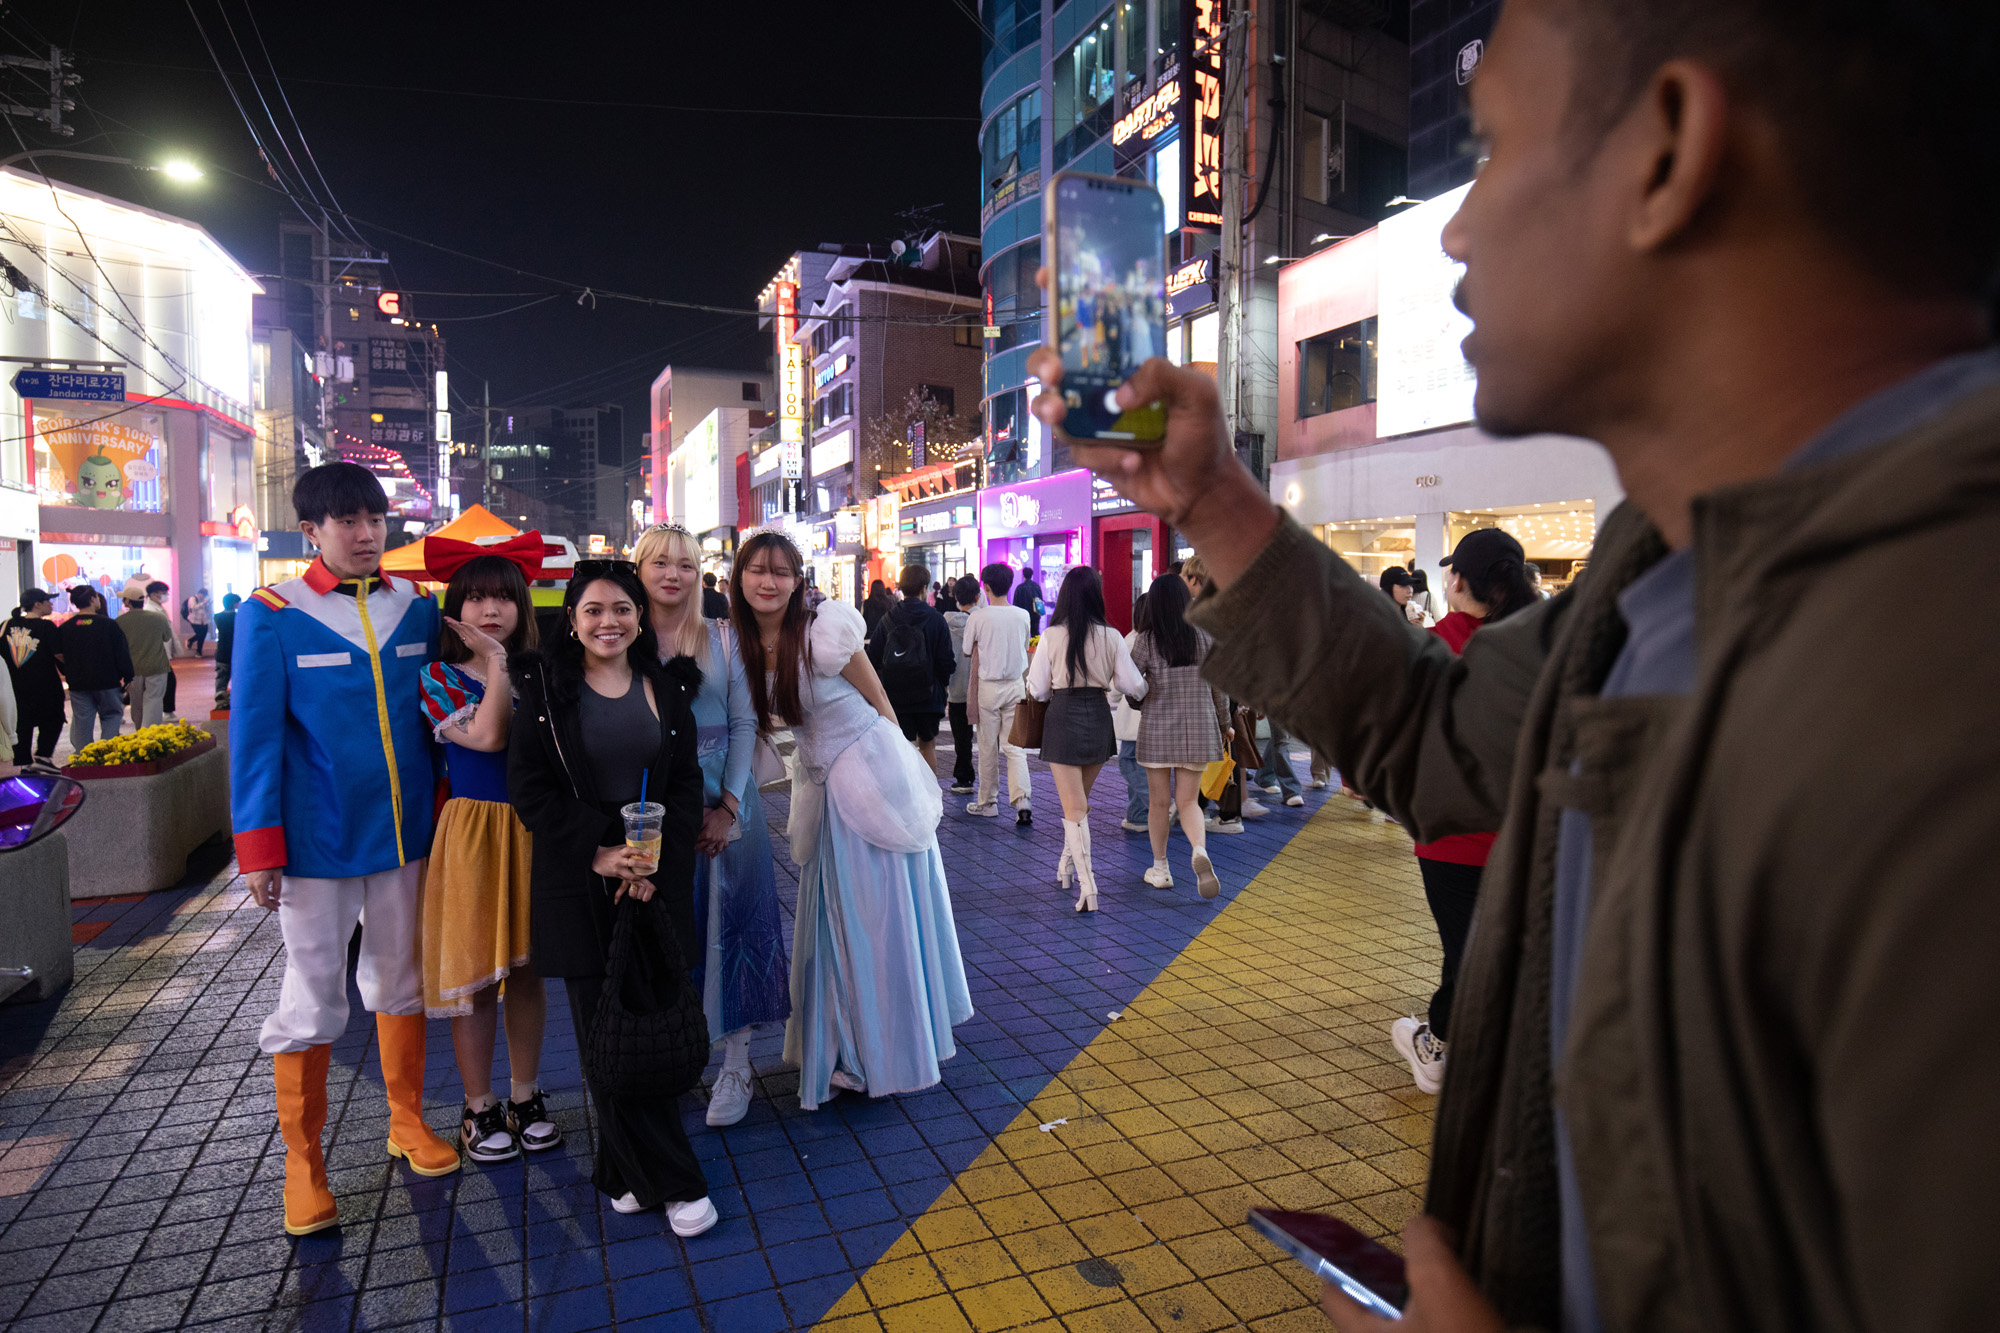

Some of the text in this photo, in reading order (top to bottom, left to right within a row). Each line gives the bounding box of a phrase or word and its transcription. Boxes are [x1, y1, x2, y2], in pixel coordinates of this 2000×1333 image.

[48, 374, 123, 391] 잔다리로2길
[786, 347, 797, 416] TATTOO
[48, 389, 122, 401] Jandari-ro 2-gil
[48, 432, 144, 455] ANNIVERSARY
[124, 426, 152, 446] 10th
[837, 535, 861, 544] SHOP
